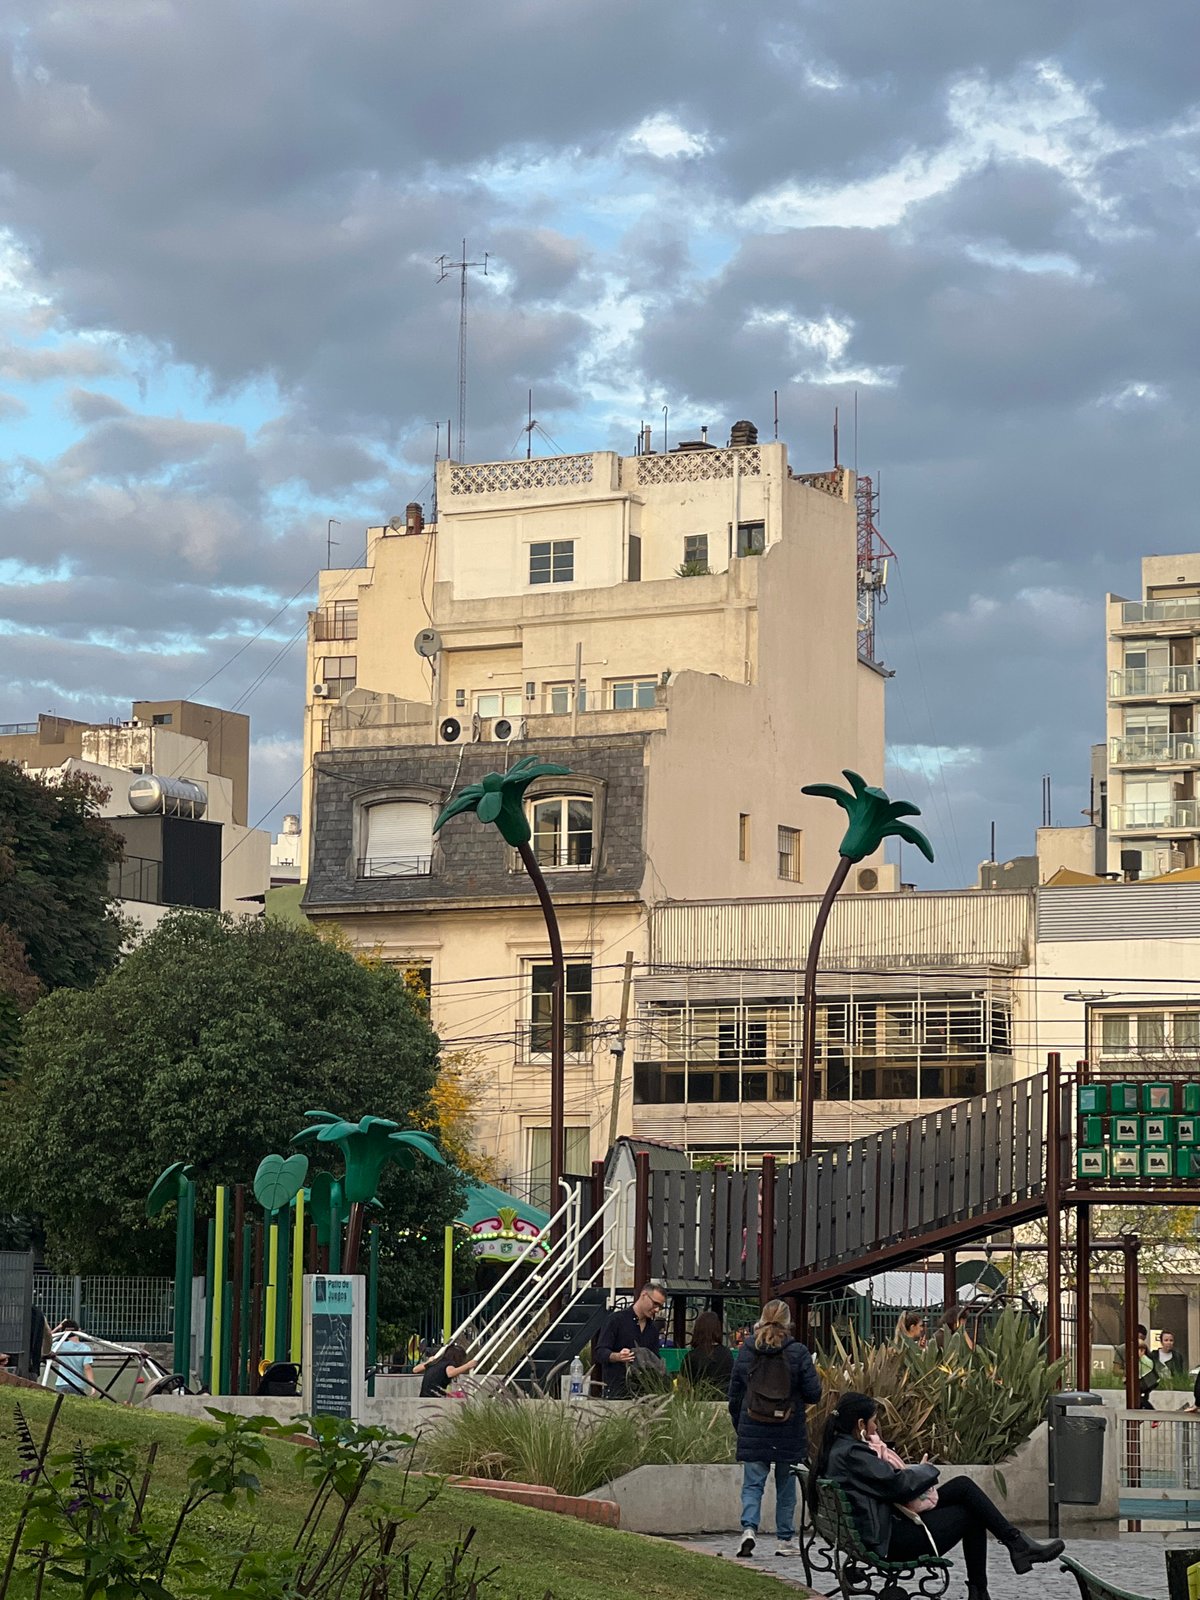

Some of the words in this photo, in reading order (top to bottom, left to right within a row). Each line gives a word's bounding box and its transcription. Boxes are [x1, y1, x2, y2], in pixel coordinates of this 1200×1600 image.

[1120, 1126, 1134, 1134] BA
[1149, 1126, 1161, 1134] BA
[1181, 1126, 1191, 1134] BA
[1085, 1158, 1099, 1166] BA
[1119, 1158, 1134, 1166] BA
[1150, 1158, 1165, 1166] BA
[328, 1280, 341, 1288] Patio
[342, 1280, 349, 1288] de
